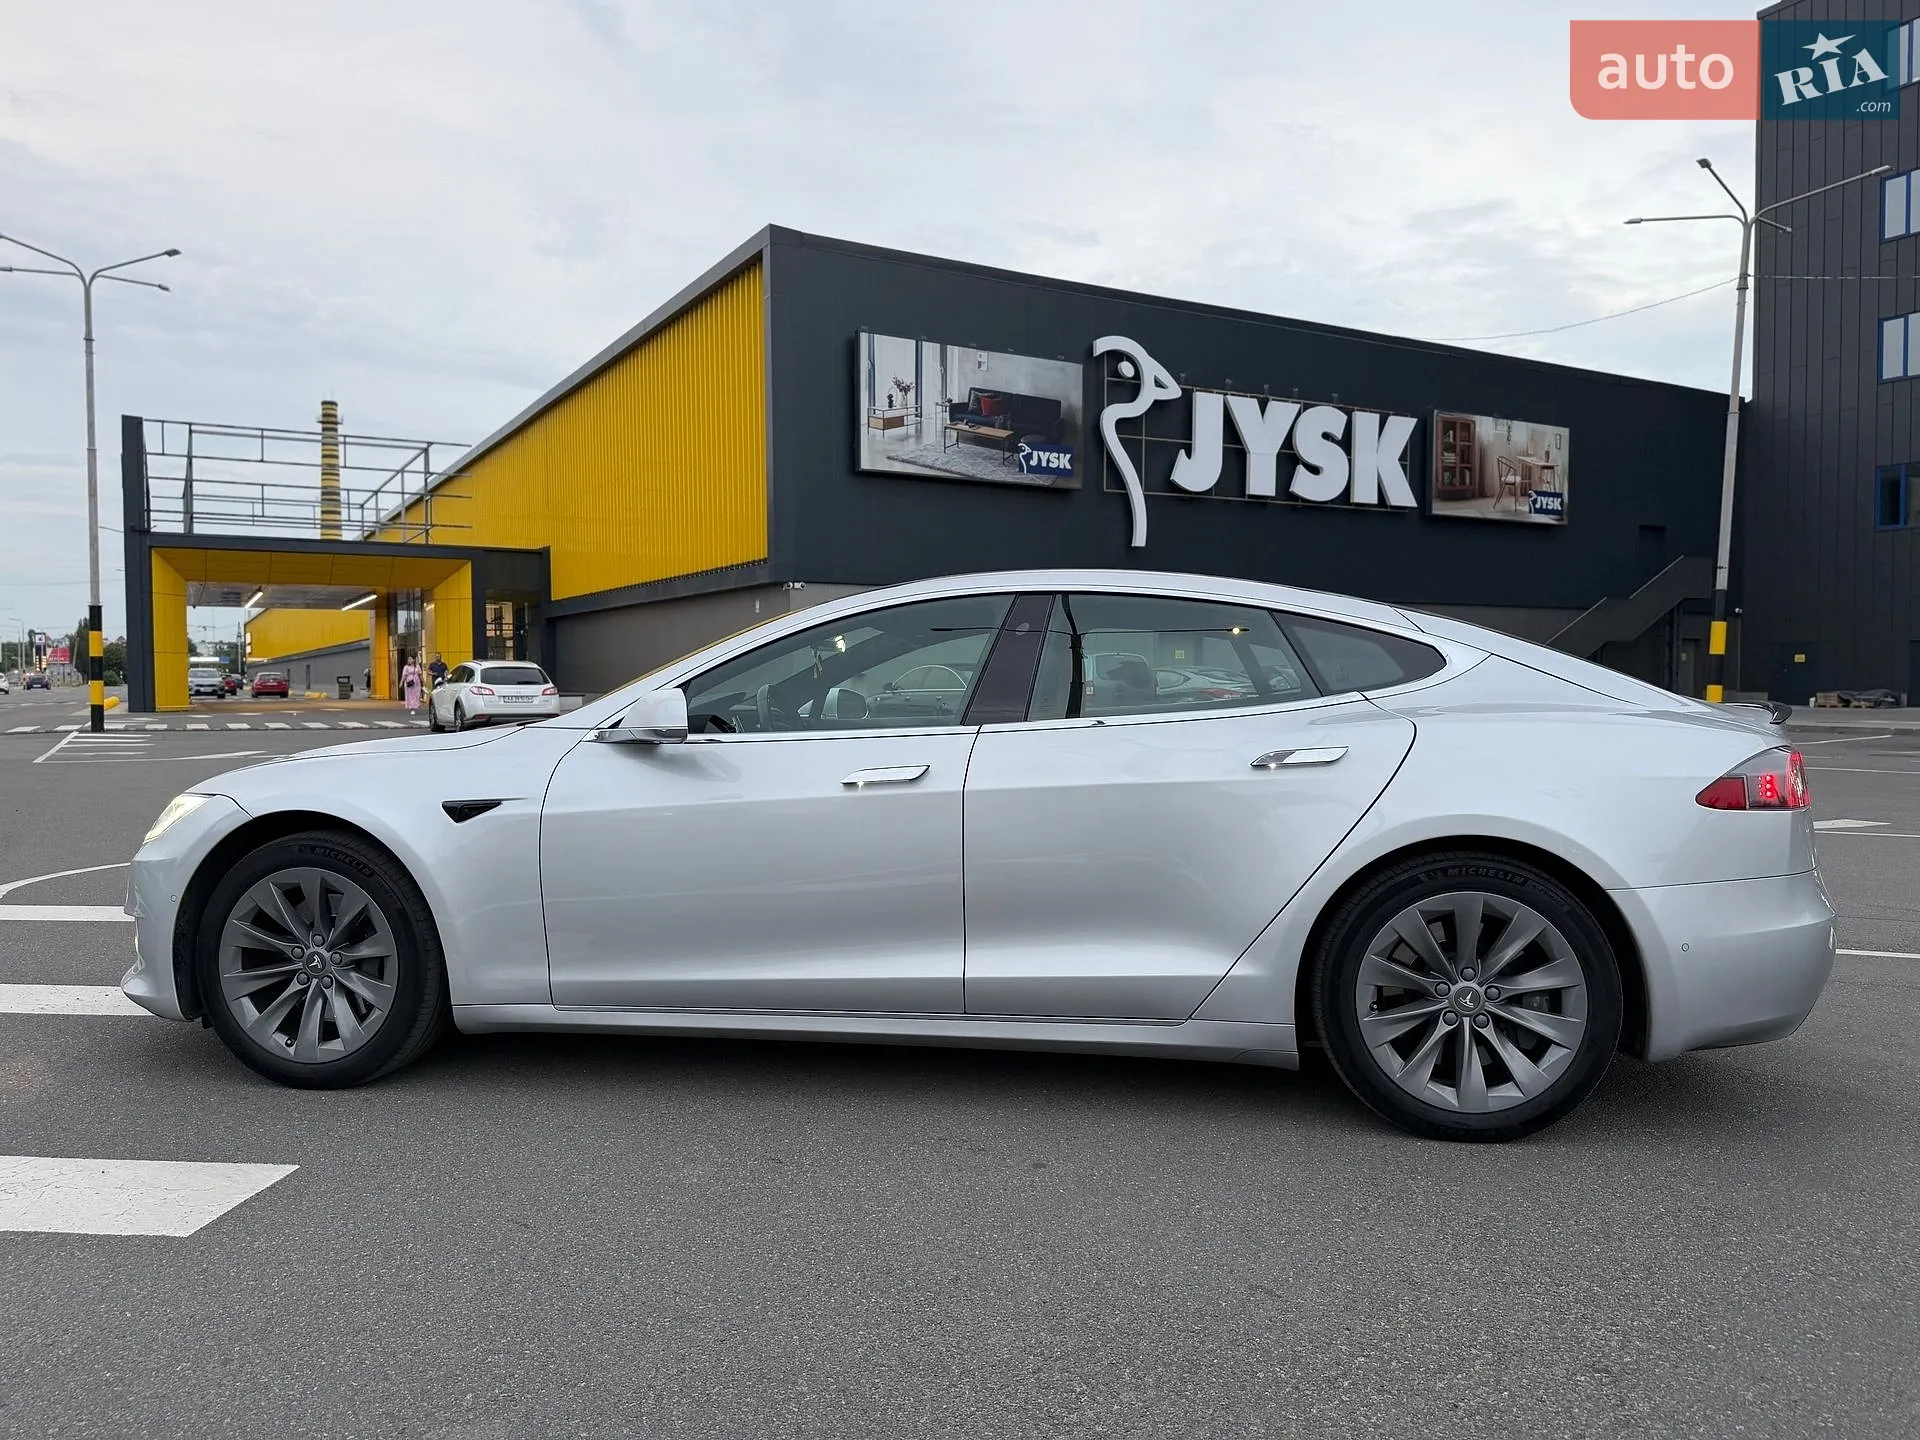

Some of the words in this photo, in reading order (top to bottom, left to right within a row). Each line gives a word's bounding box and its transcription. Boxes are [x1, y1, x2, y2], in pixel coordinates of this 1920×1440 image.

[1170, 391, 1418, 508] JYSK
[1029, 450, 1072, 470] JYSK
[1535, 495, 1562, 511] JYSK
[313, 847, 374, 876] MICHELIN
[1447, 867, 1525, 884] MICHELIN
